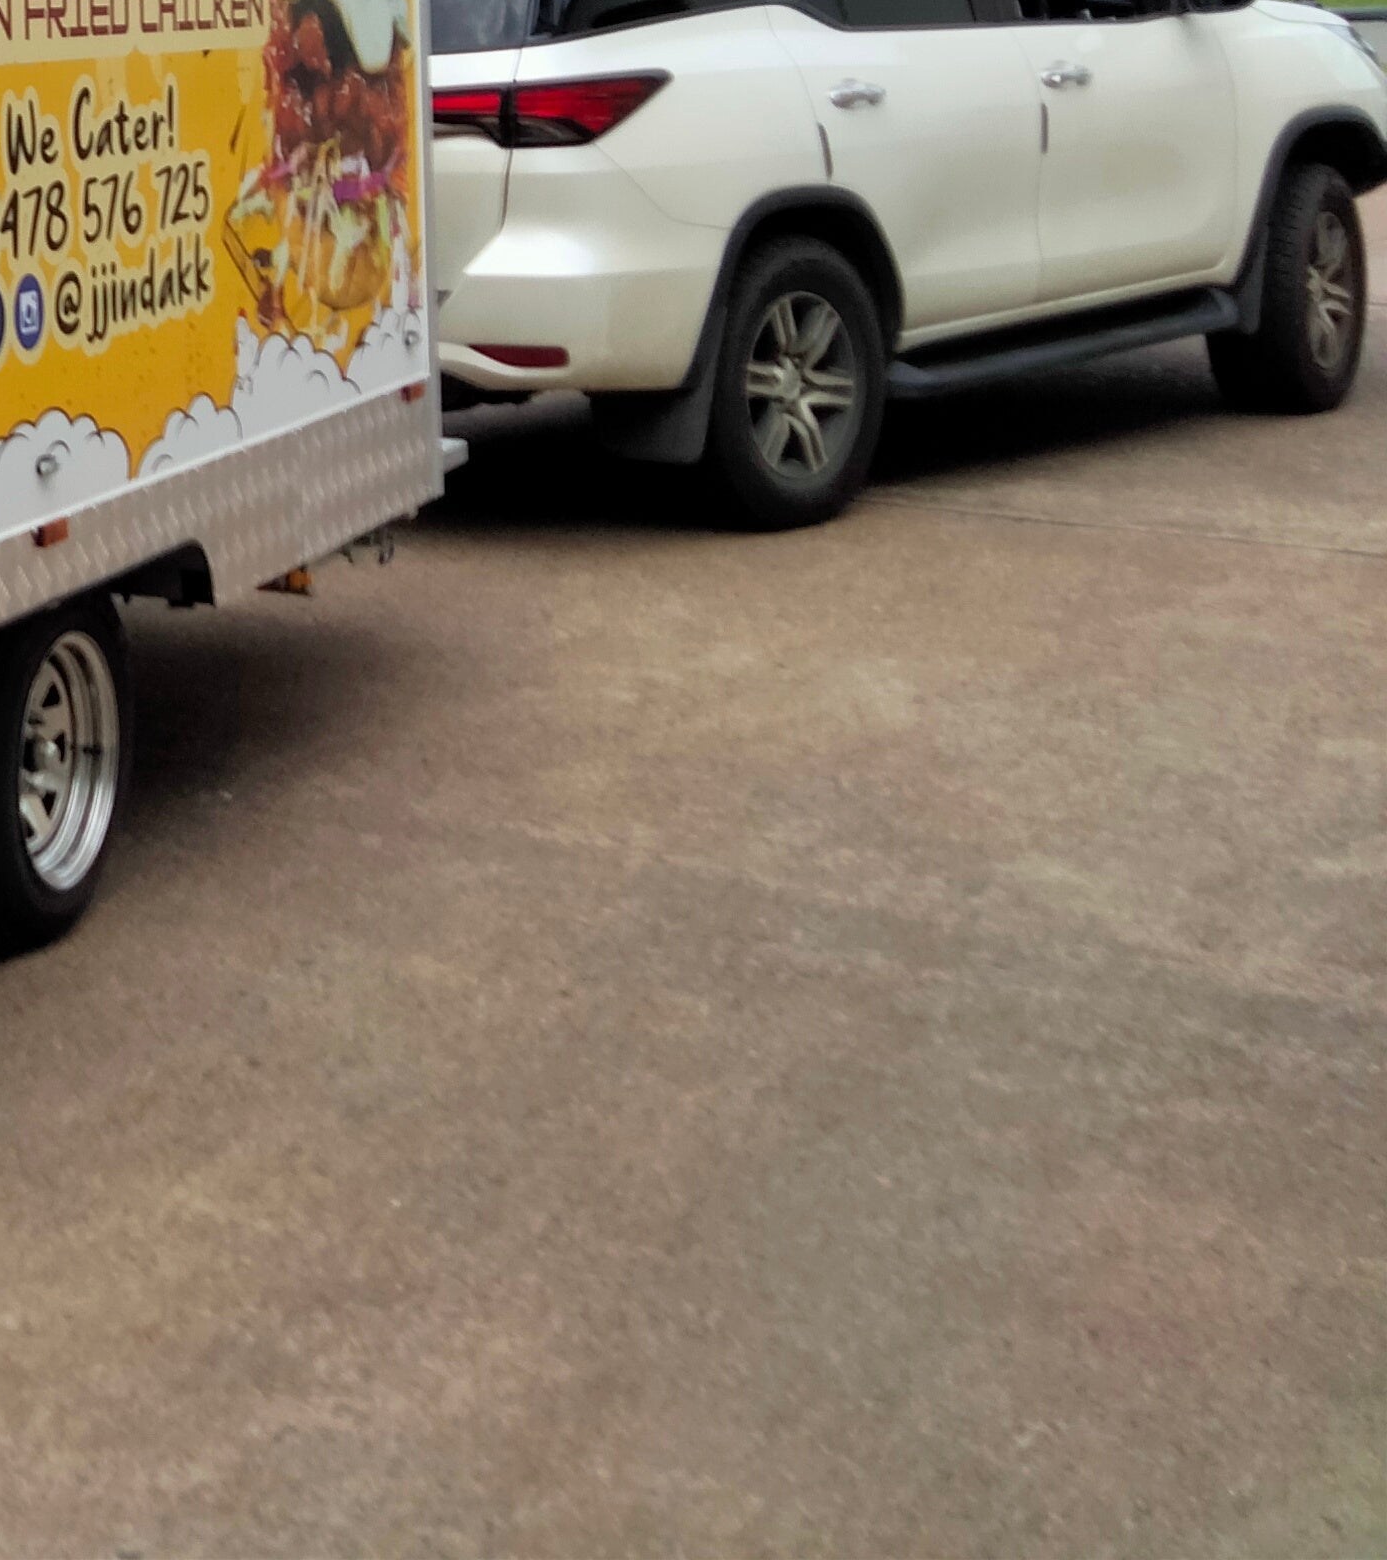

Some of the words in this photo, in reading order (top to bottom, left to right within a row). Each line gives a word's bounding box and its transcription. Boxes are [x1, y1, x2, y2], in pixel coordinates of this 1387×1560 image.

[6, 98, 59, 175] We
[73, 84, 175, 161] Cater!
[83, 170, 142, 243] 576
[156, 160, 210, 230] 725
[55, 233, 210, 342] @jjindakk
